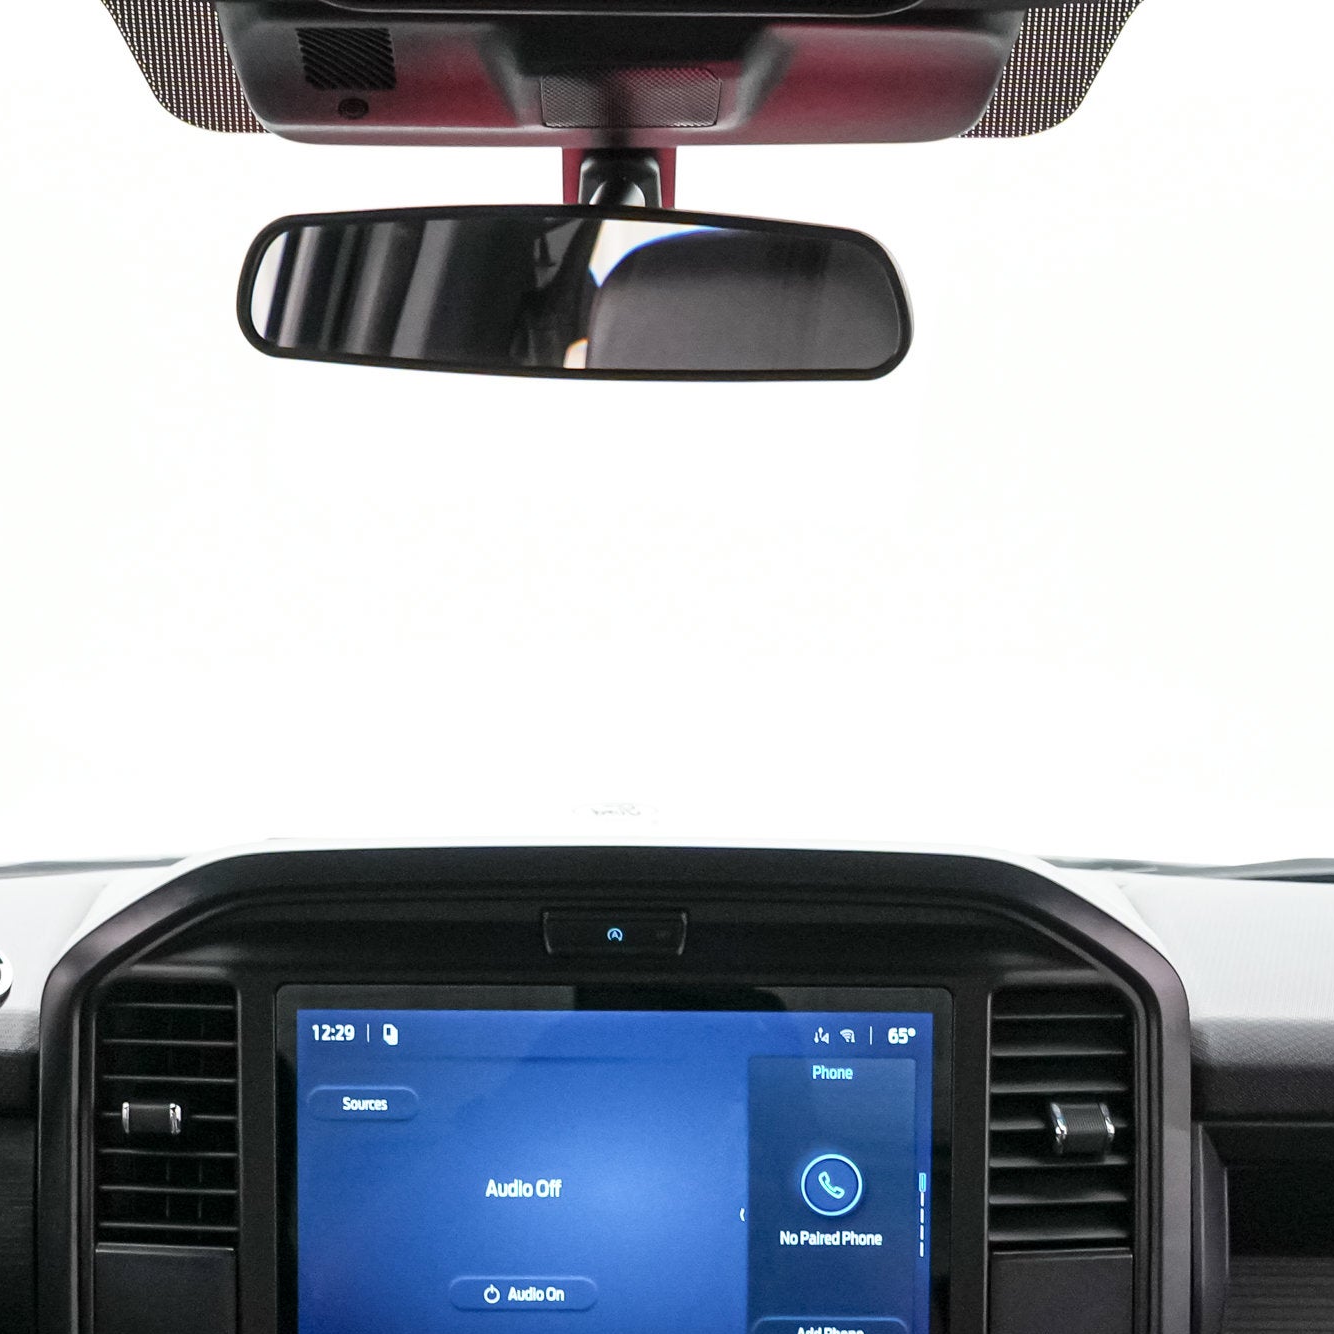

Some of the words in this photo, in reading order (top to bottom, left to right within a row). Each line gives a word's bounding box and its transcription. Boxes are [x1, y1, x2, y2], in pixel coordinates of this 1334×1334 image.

[312, 1024, 355, 1042] 12:29
[812, 1065, 853, 1081] Phone
[342, 1097, 388, 1112] Sources
[485, 1179, 533, 1198] Audio
[536, 1178, 562, 1198] Off
[779, 1231, 797, 1246] No
[799, 1231, 842, 1246] Paired
[843, 1231, 883, 1246] Phone
[507, 1286, 545, 1302] Audio
[547, 1286, 565, 1302] On
